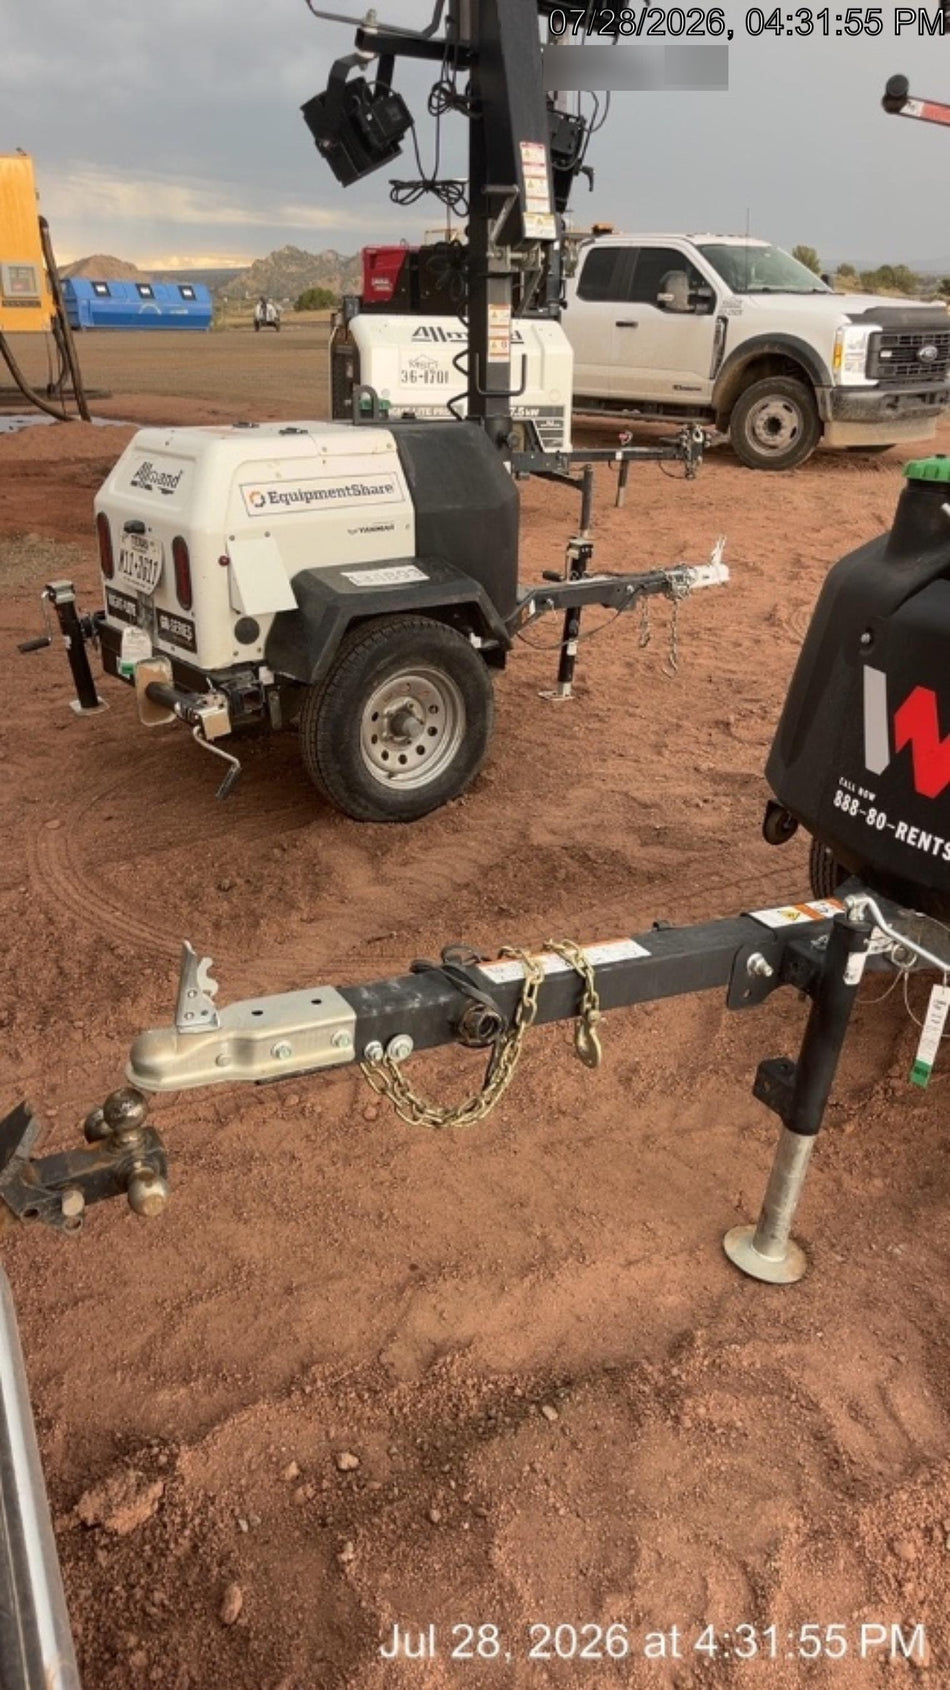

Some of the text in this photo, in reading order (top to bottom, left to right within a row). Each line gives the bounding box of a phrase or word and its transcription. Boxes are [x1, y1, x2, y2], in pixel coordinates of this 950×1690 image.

[267, 483, 394, 506] EquipmentShare
[839, 776, 877, 802] CALL NOW
[833, 789, 950, 861] 888-80-RENTS
